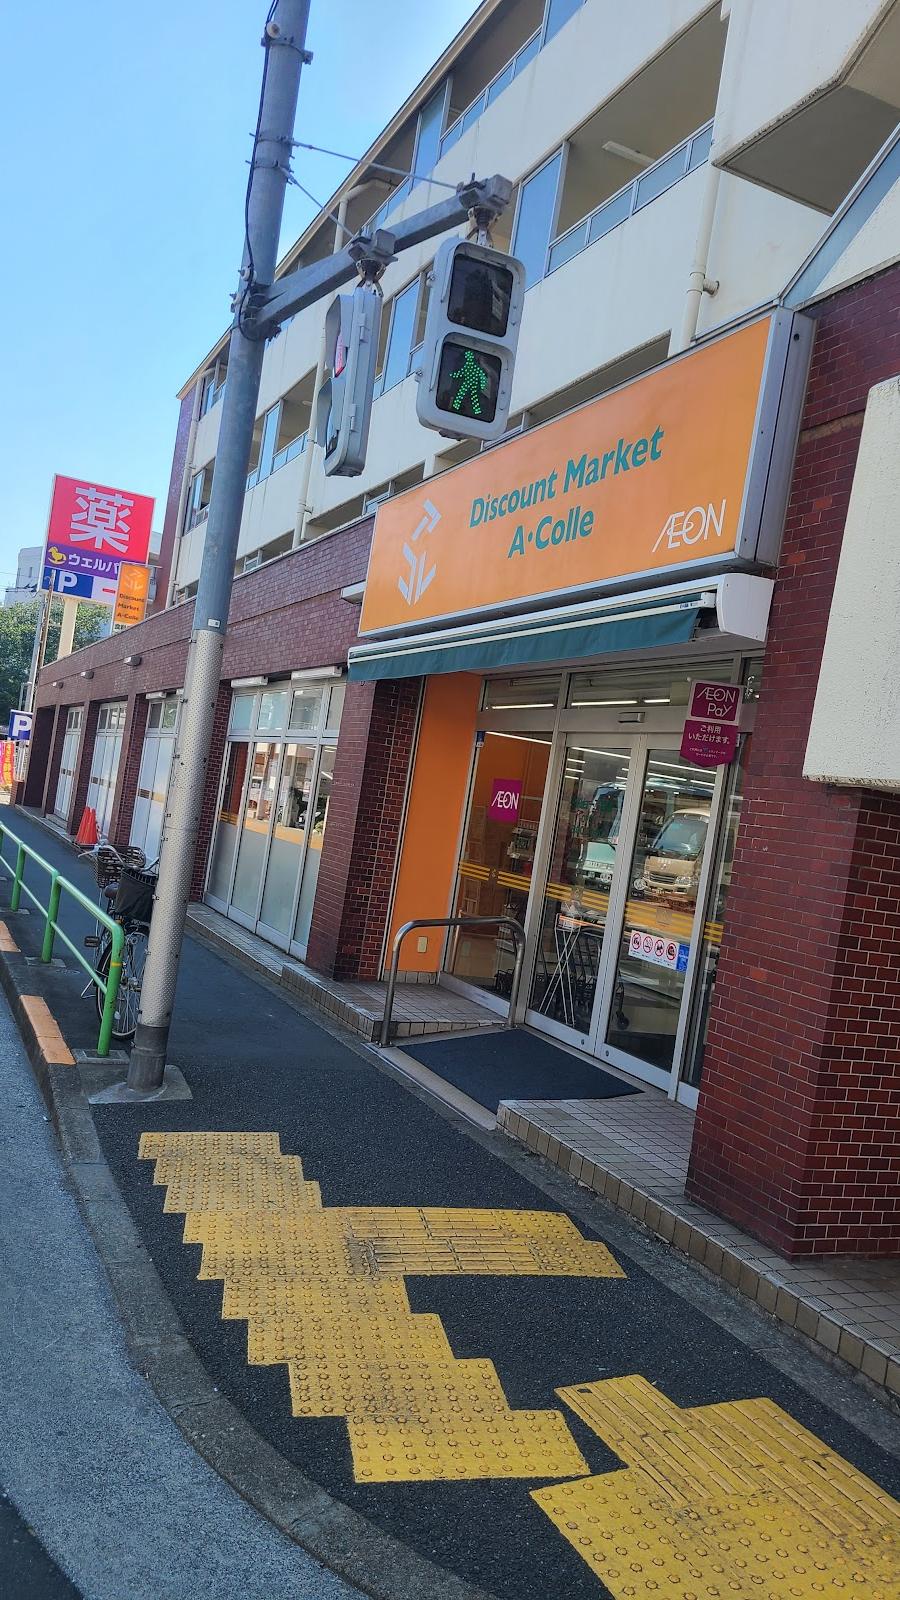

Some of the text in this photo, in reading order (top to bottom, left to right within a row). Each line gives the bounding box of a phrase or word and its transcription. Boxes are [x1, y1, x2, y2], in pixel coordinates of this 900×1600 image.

[469, 425, 664, 528] Discount Market
[70, 487, 134, 553] 薬
[57, 571, 78, 593] P
[707, 702, 733, 717] Pay
[12, 714, 33, 737] P
[700, 724, 721, 734] ご利用
